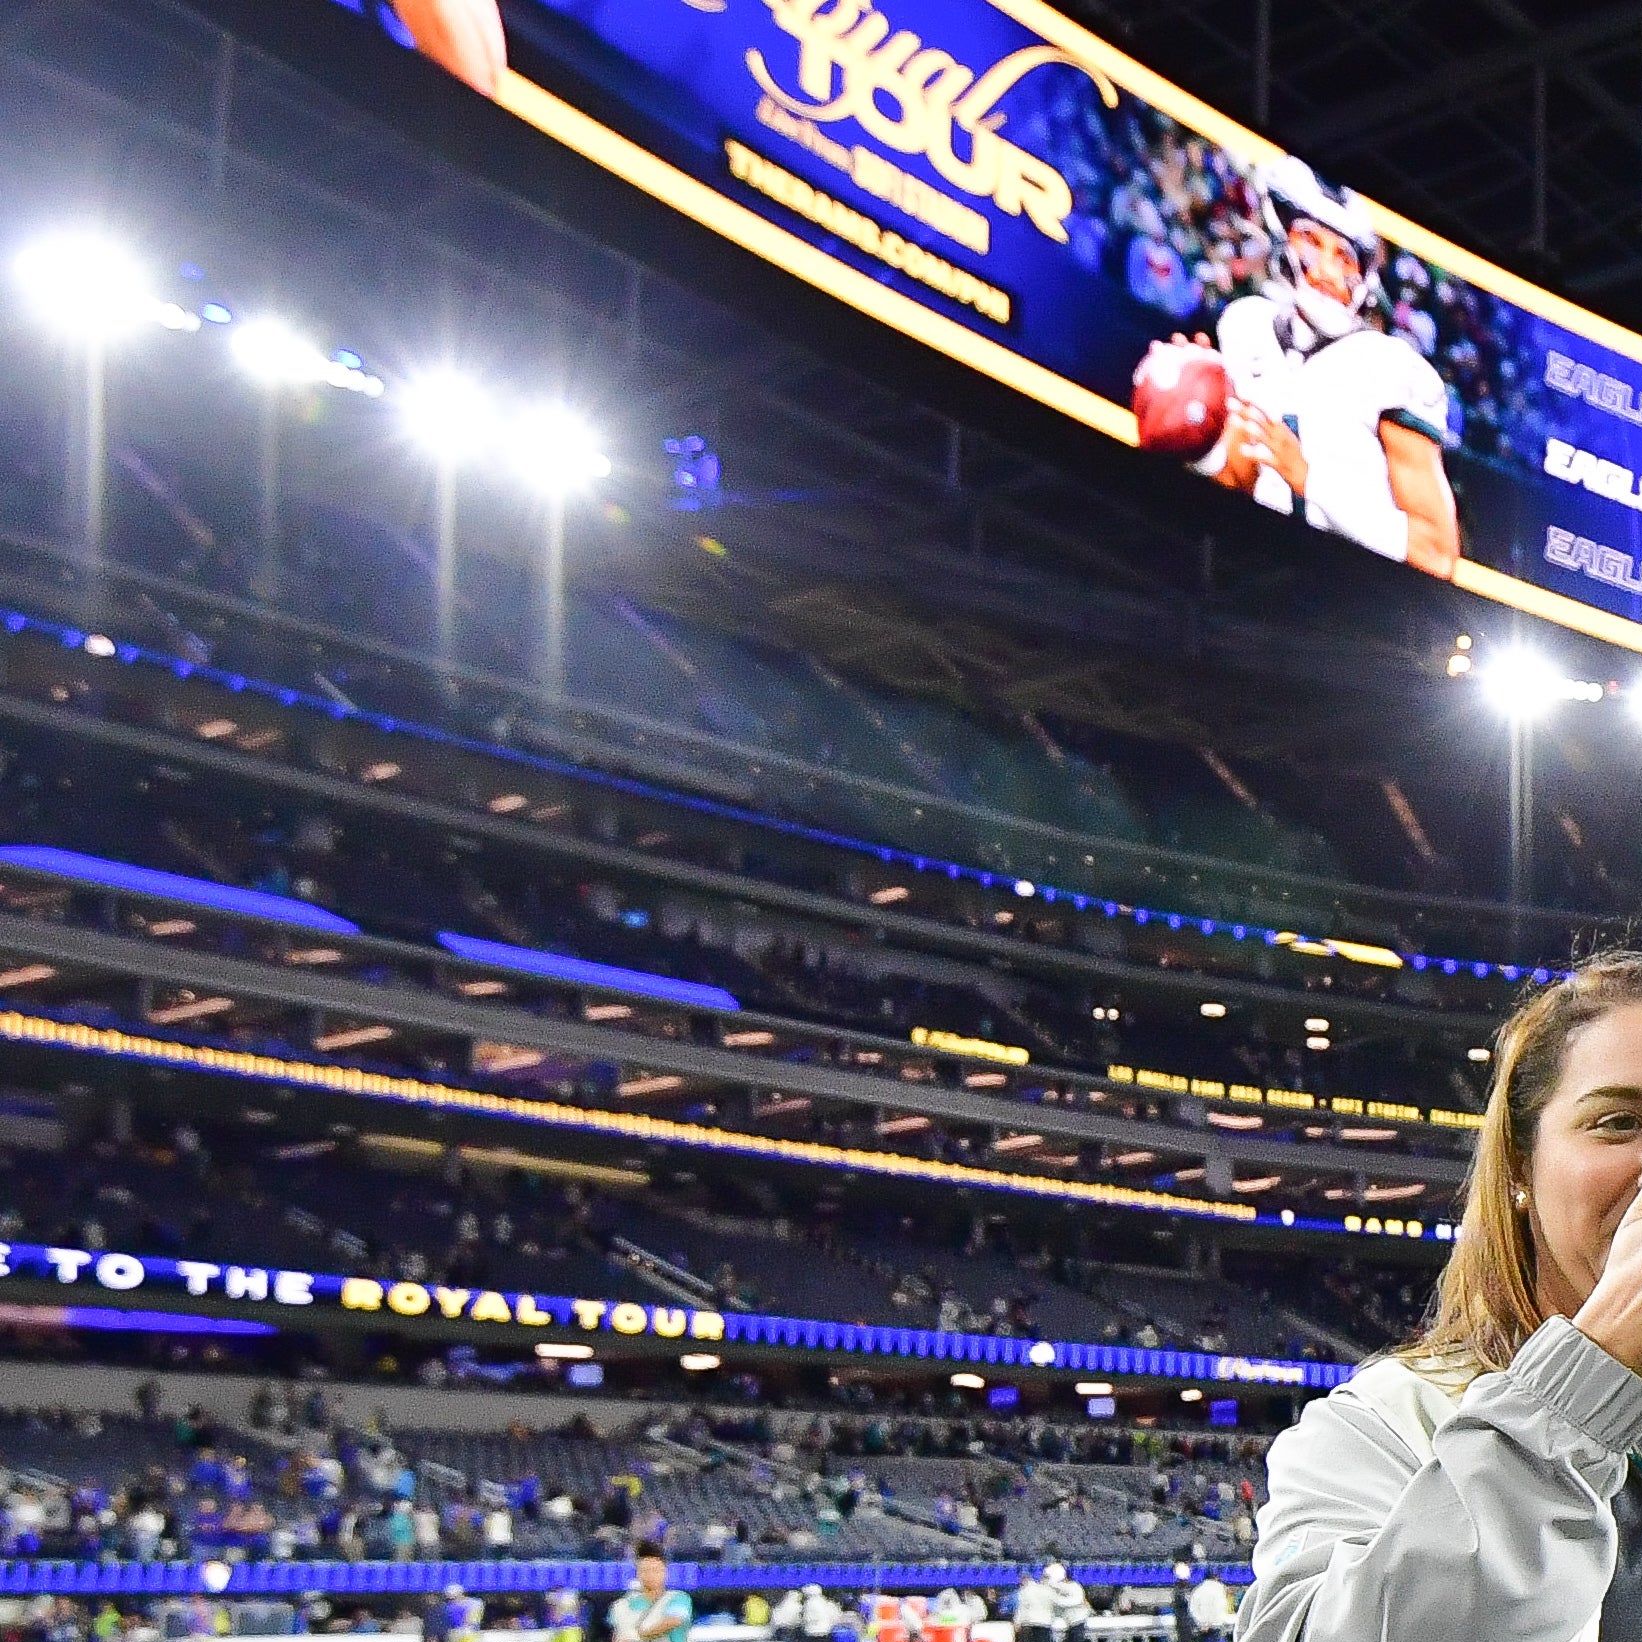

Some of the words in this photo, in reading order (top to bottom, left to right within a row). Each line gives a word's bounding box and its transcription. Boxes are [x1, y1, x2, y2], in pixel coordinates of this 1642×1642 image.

[46, 1248, 145, 1290] TO
[176, 1260, 314, 1305] THE
[341, 1278, 552, 1327] ROYAL
[572, 1299, 725, 1341] TOUR
